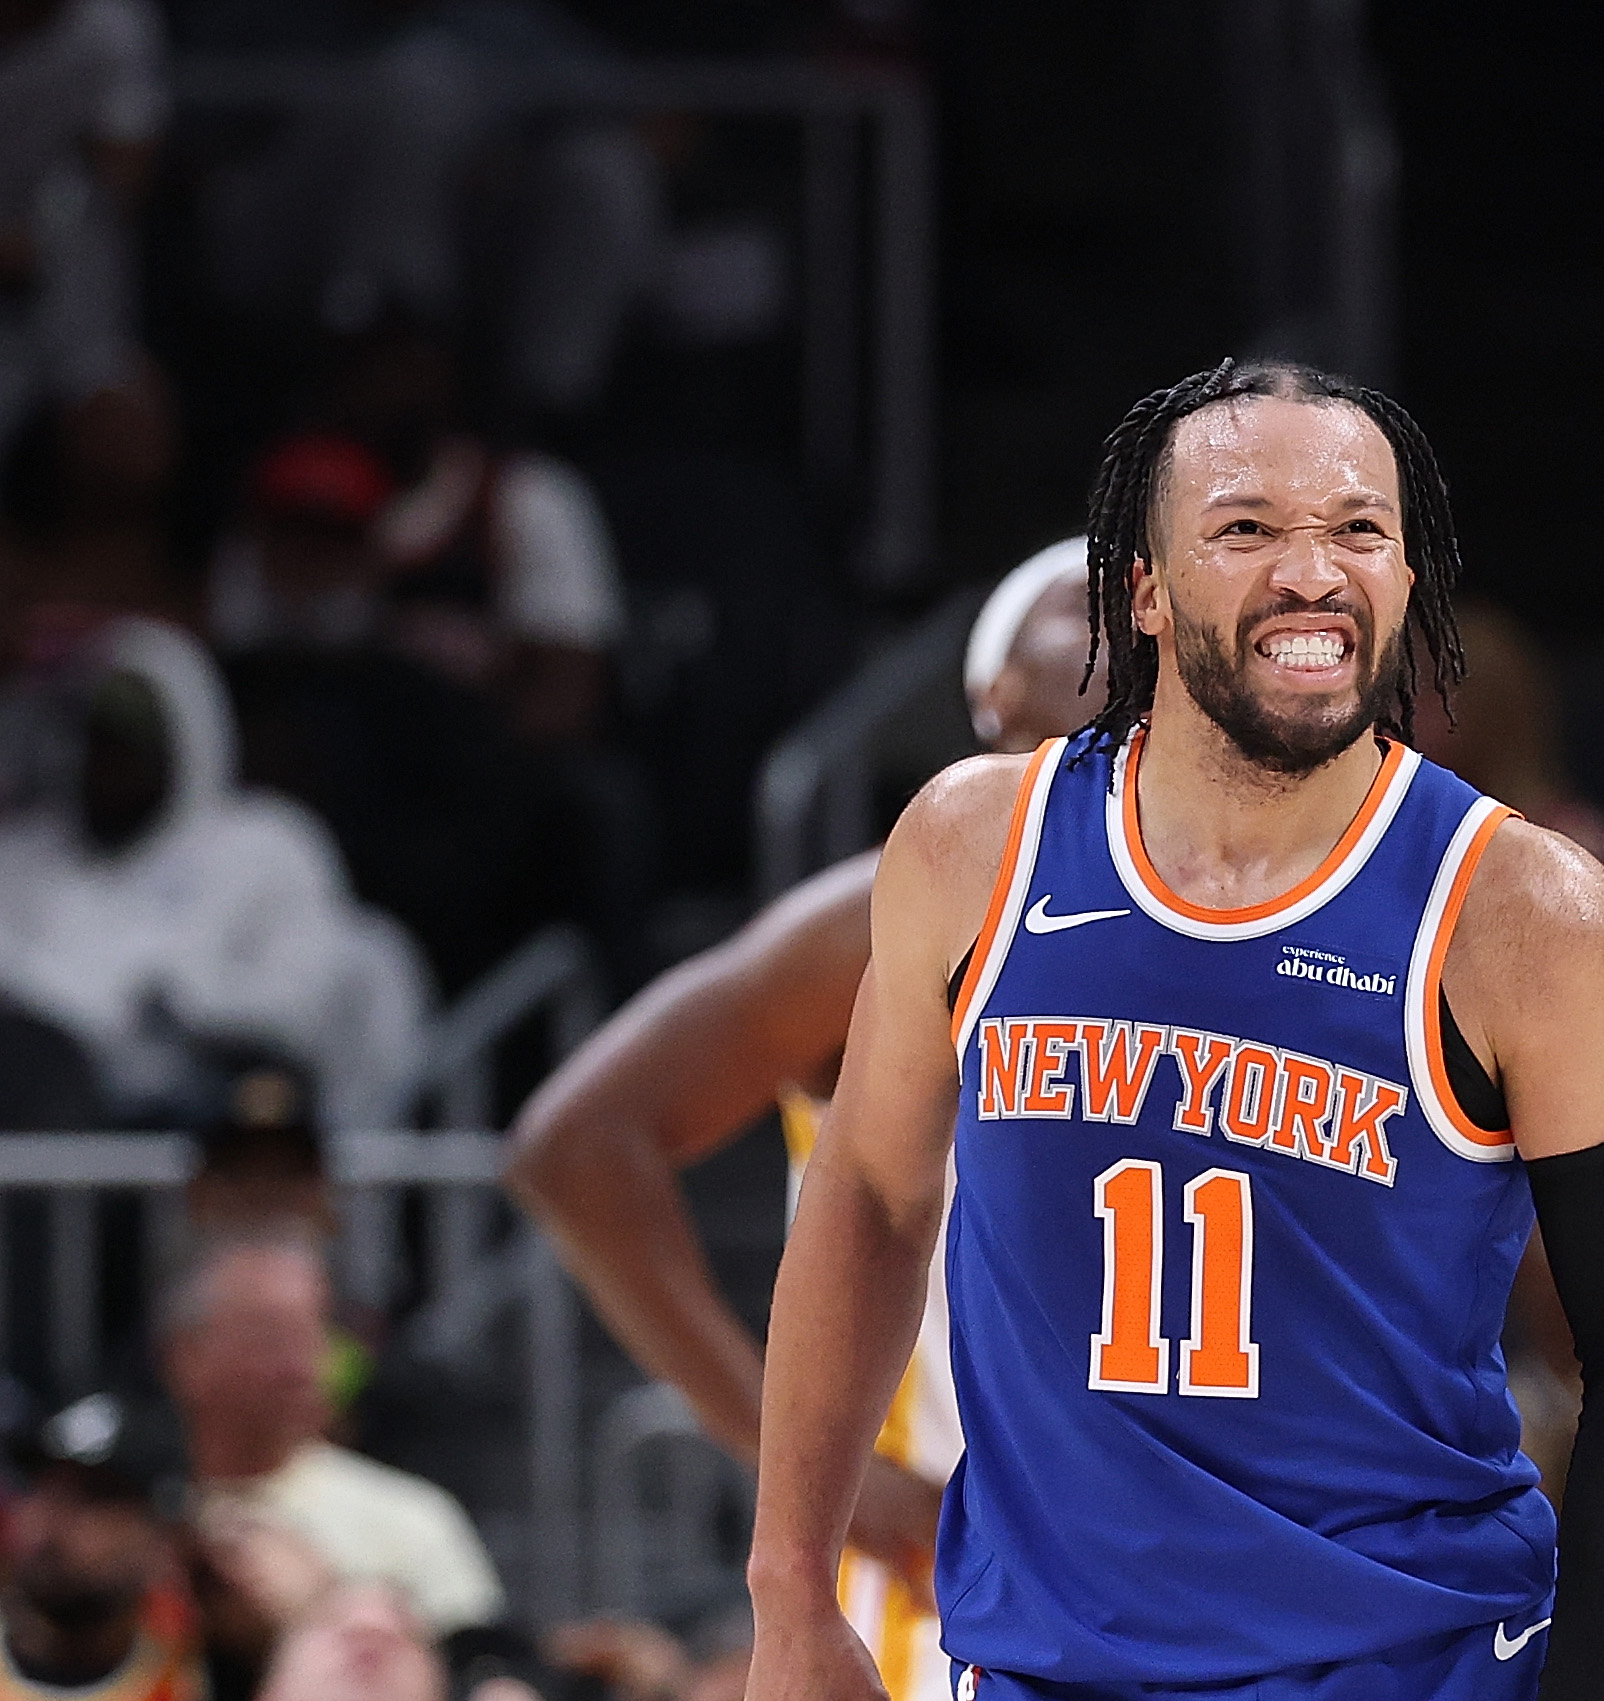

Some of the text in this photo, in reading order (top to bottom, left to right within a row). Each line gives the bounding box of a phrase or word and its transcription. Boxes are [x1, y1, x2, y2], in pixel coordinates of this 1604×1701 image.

[1276, 957, 1397, 995] abu dhabi
[1282, 945, 1346, 964] experience
[979, 1016, 1408, 1188] NEW YORK
[1089, 1158, 1260, 1398] 11
